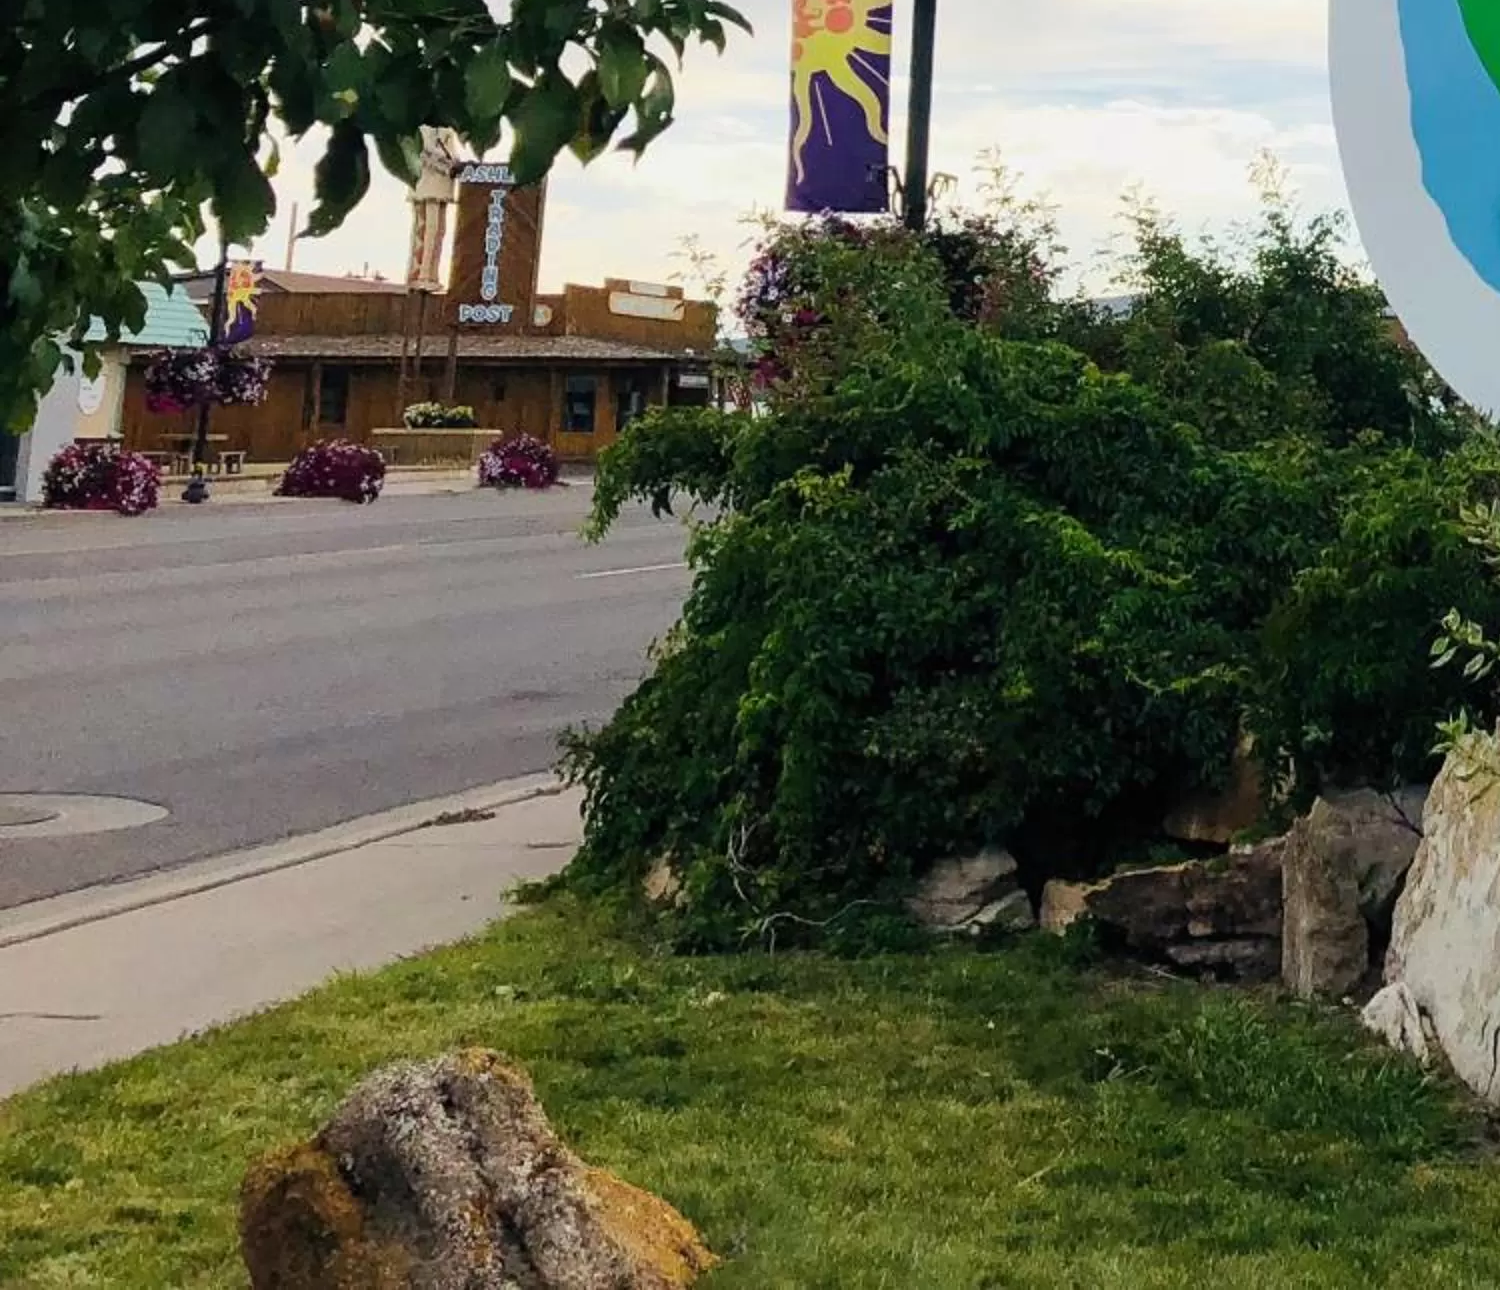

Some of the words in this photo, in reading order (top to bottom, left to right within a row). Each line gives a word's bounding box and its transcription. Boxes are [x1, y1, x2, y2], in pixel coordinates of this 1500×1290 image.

[461, 165, 516, 183] ASHL
[480, 189, 507, 301] TRADING
[458, 303, 513, 323] POST
